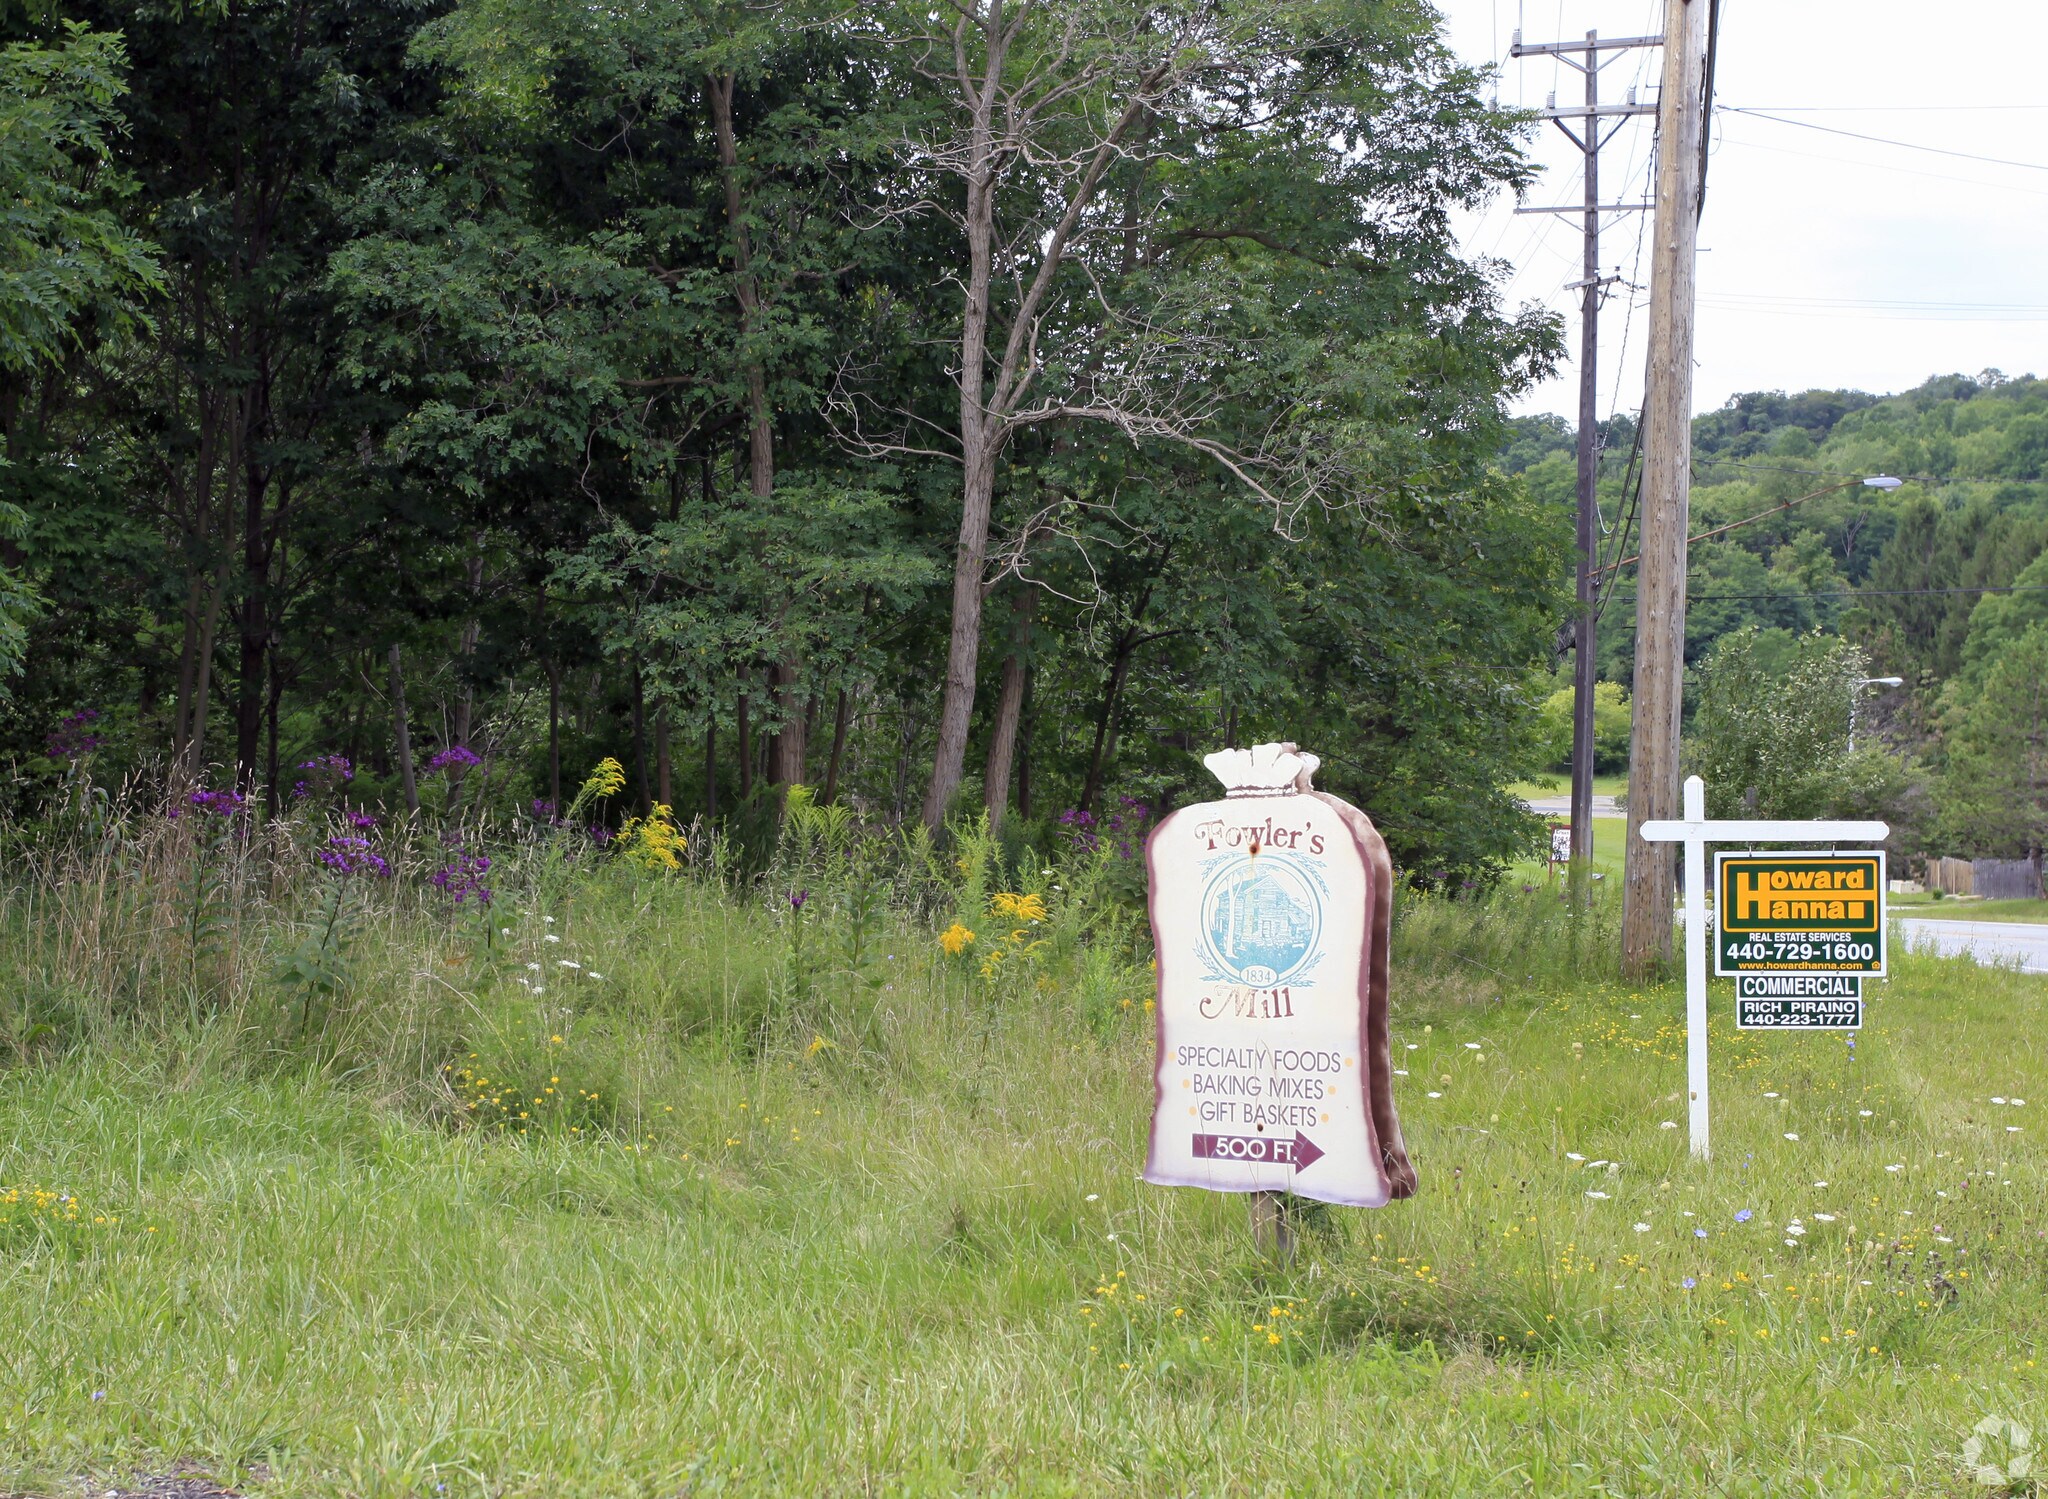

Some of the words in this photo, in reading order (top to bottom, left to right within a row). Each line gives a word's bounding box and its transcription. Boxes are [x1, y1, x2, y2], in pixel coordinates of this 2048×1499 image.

[1194, 817, 1325, 855] Fowler's
[1737, 869, 1865, 896] Howard
[1749, 933, 1773, 942] REAL
[1774, 932, 1807, 942] ESTATE
[1808, 932, 1851, 942] SERVICES
[1727, 943, 1874, 960] 440-729-1600
[1245, 969, 1272, 983] 1834
[1738, 962, 1863, 970] www.howardhanna.com
[1743, 977, 1855, 995] COMMERCIAL
[1199, 985, 1295, 1020] Mill
[1744, 1002, 1782, 1013] RICH
[1791, 1002, 1855, 1013] PIRAINO
[1744, 1014, 1856, 1025] 440-223-1777
[1177, 1045, 1267, 1069] SPECIALTY
[1274, 1050, 1341, 1073] FOODS
[1193, 1073, 1262, 1096] BAKING
[1269, 1077, 1324, 1100] MIXES
[1200, 1101, 1236, 1122] GIFT
[1243, 1103, 1317, 1127] BASKETS
[1215, 1137, 1267, 1159] 500
[1273, 1139, 1298, 1161] FT.
